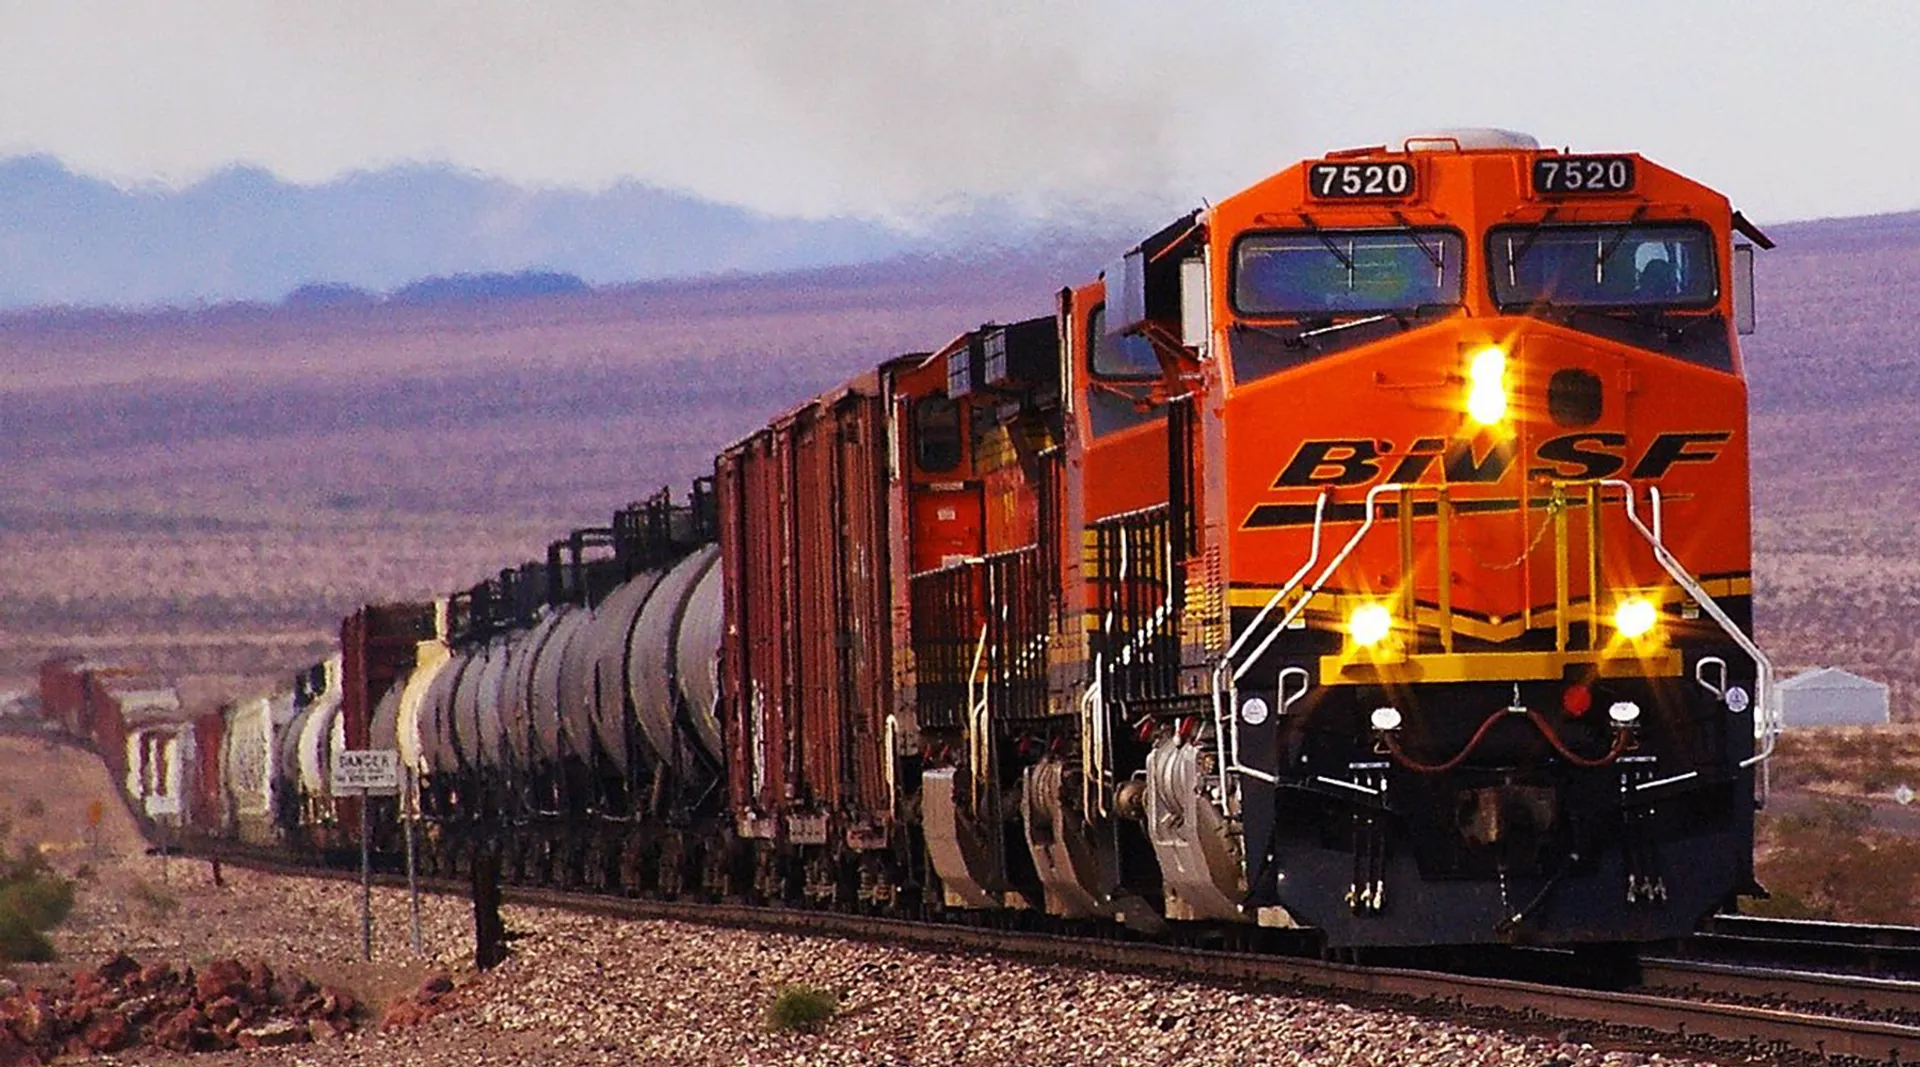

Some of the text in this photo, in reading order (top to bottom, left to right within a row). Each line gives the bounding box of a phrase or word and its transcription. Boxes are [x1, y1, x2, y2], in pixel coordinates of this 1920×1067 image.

[1318, 165, 1408, 195] 7520
[1542, 160, 1627, 189] 7520
[1272, 431, 1732, 488] BNSF
